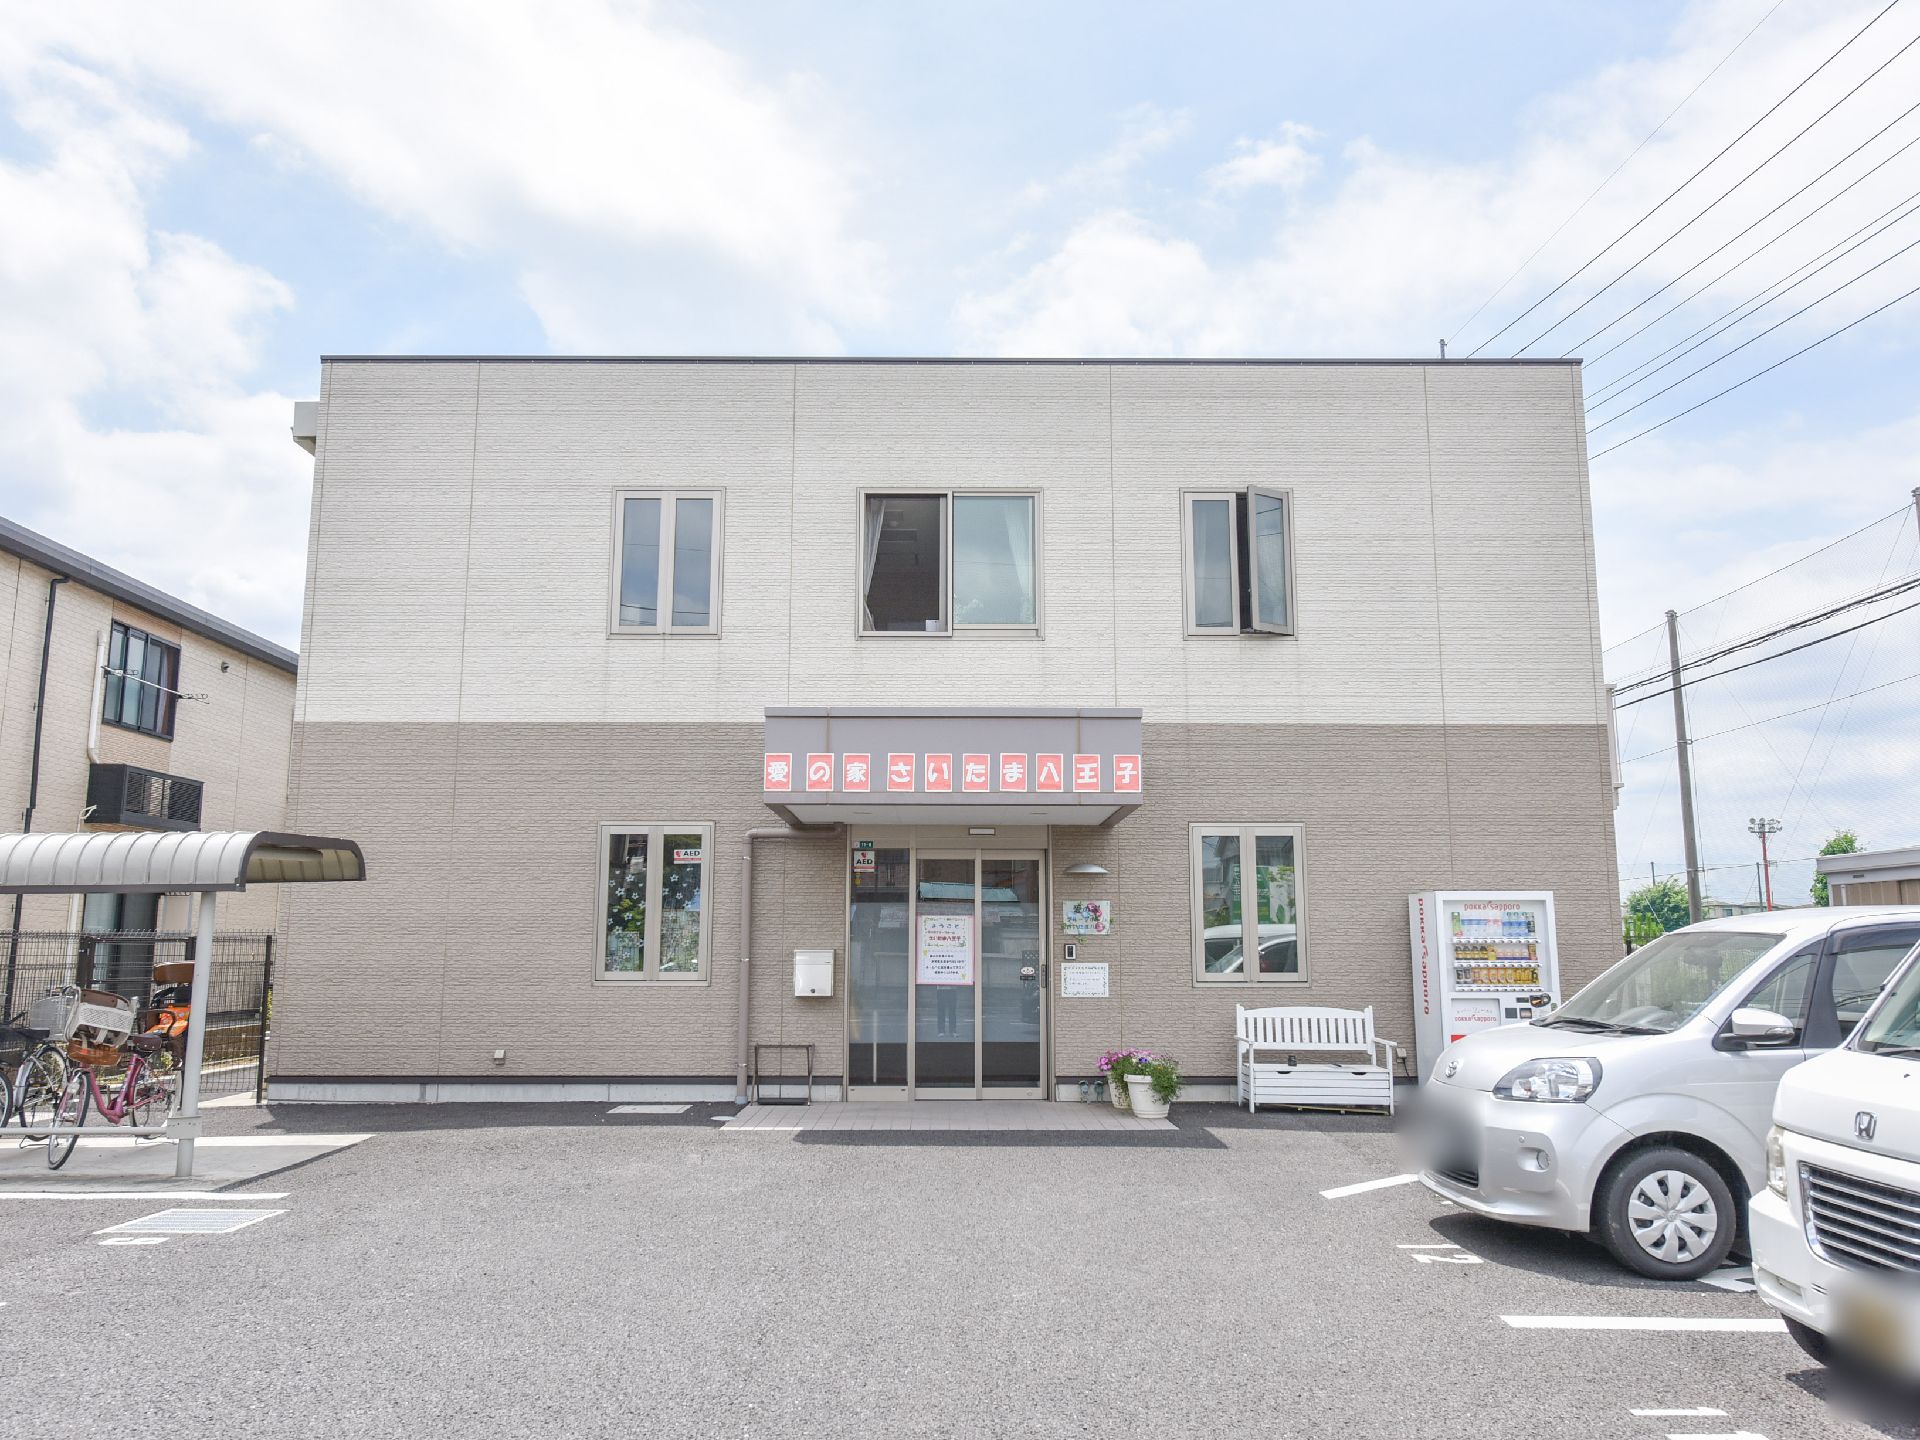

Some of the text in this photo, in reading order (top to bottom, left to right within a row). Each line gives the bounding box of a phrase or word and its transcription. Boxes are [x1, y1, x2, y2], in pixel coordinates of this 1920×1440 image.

[768, 761, 1137, 784] 愛の家 さいたま八王子
